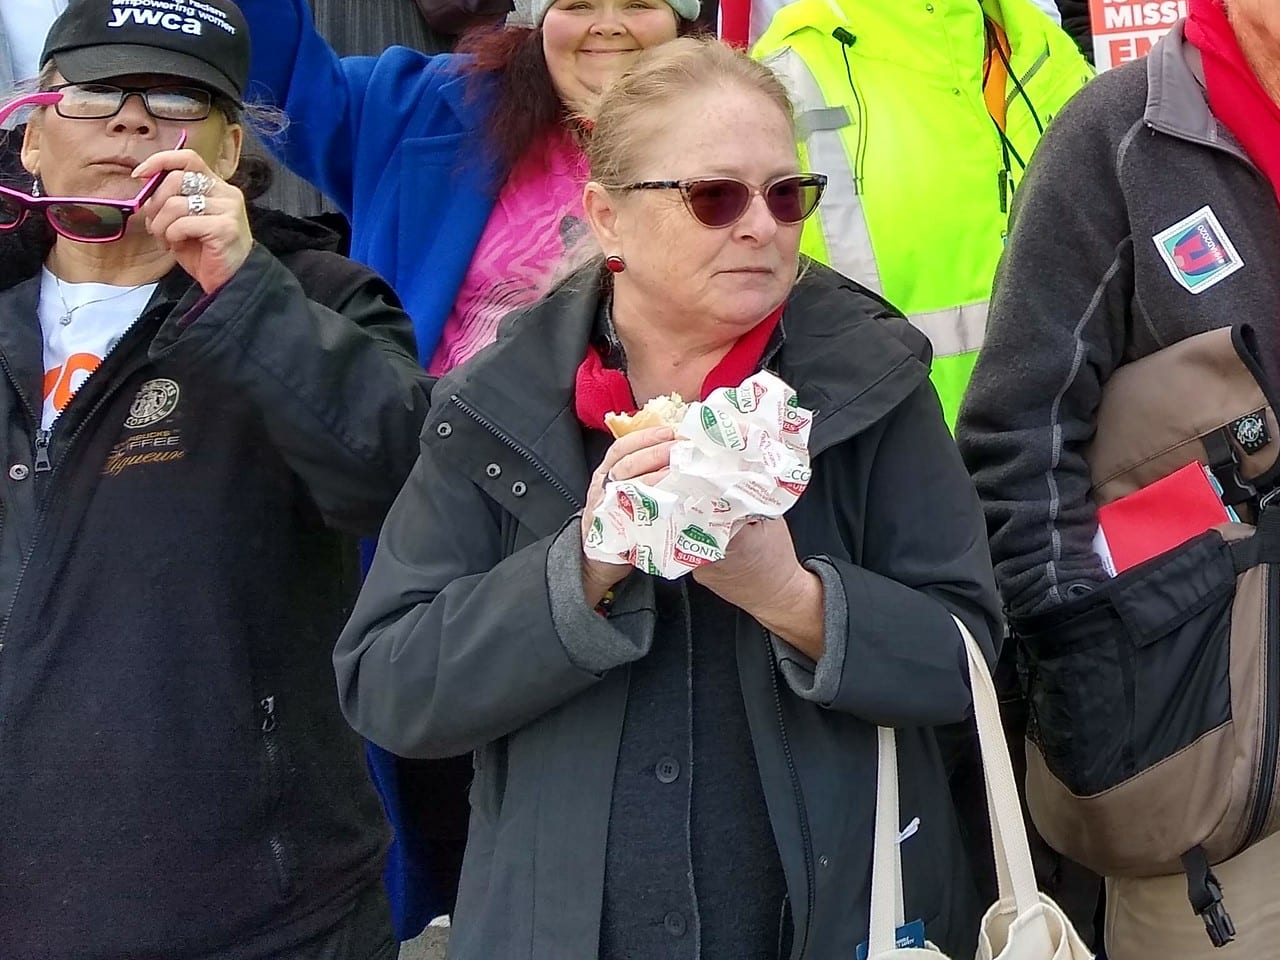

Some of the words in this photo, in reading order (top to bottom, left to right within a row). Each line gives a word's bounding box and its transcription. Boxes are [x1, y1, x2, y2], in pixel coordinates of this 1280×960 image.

[108, 7, 202, 35] ywca
[198, 10, 237, 35] women
[1104, 0, 1187, 29] MISSI
[676, 553, 702, 565] SUBS
